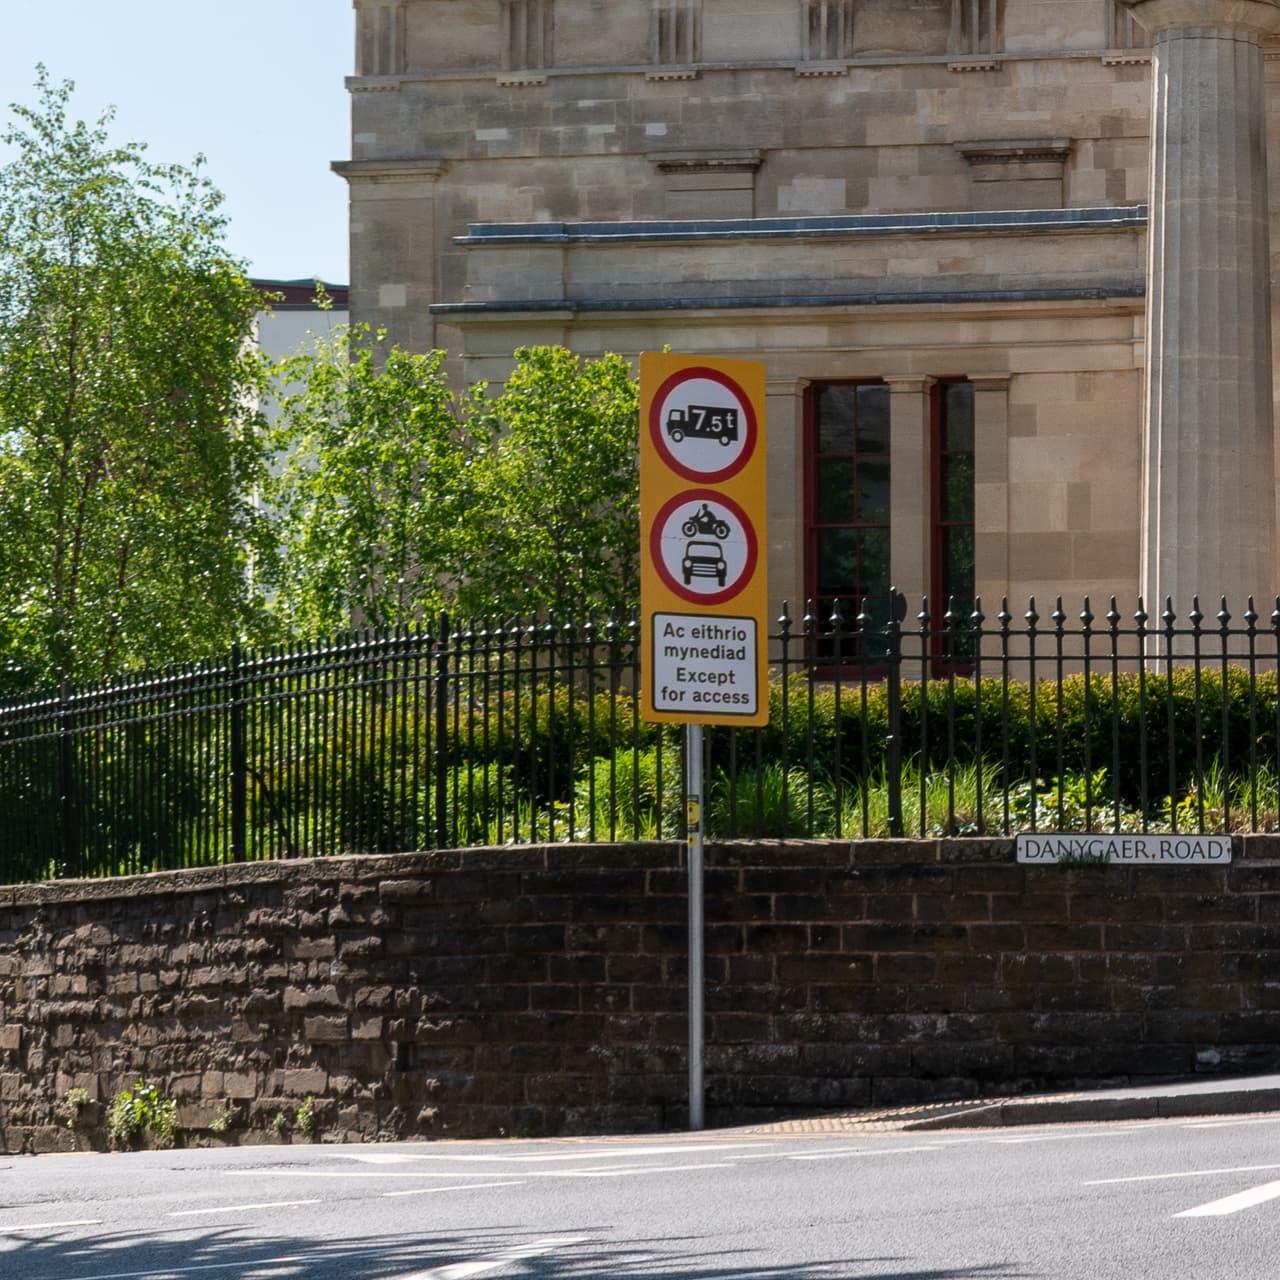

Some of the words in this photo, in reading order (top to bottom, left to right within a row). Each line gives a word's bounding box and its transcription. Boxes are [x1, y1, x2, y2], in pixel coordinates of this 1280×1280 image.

[663, 622, 685, 638] Ac
[691, 624, 747, 641] eithrio
[664, 645, 746, 661] mynediad
[676, 667, 735, 686] Except
[661, 686, 686, 701] for
[692, 691, 750, 705] access
[1025, 839, 1148, 859] DANYGAER
[1160, 840, 1223, 859] ROAD
